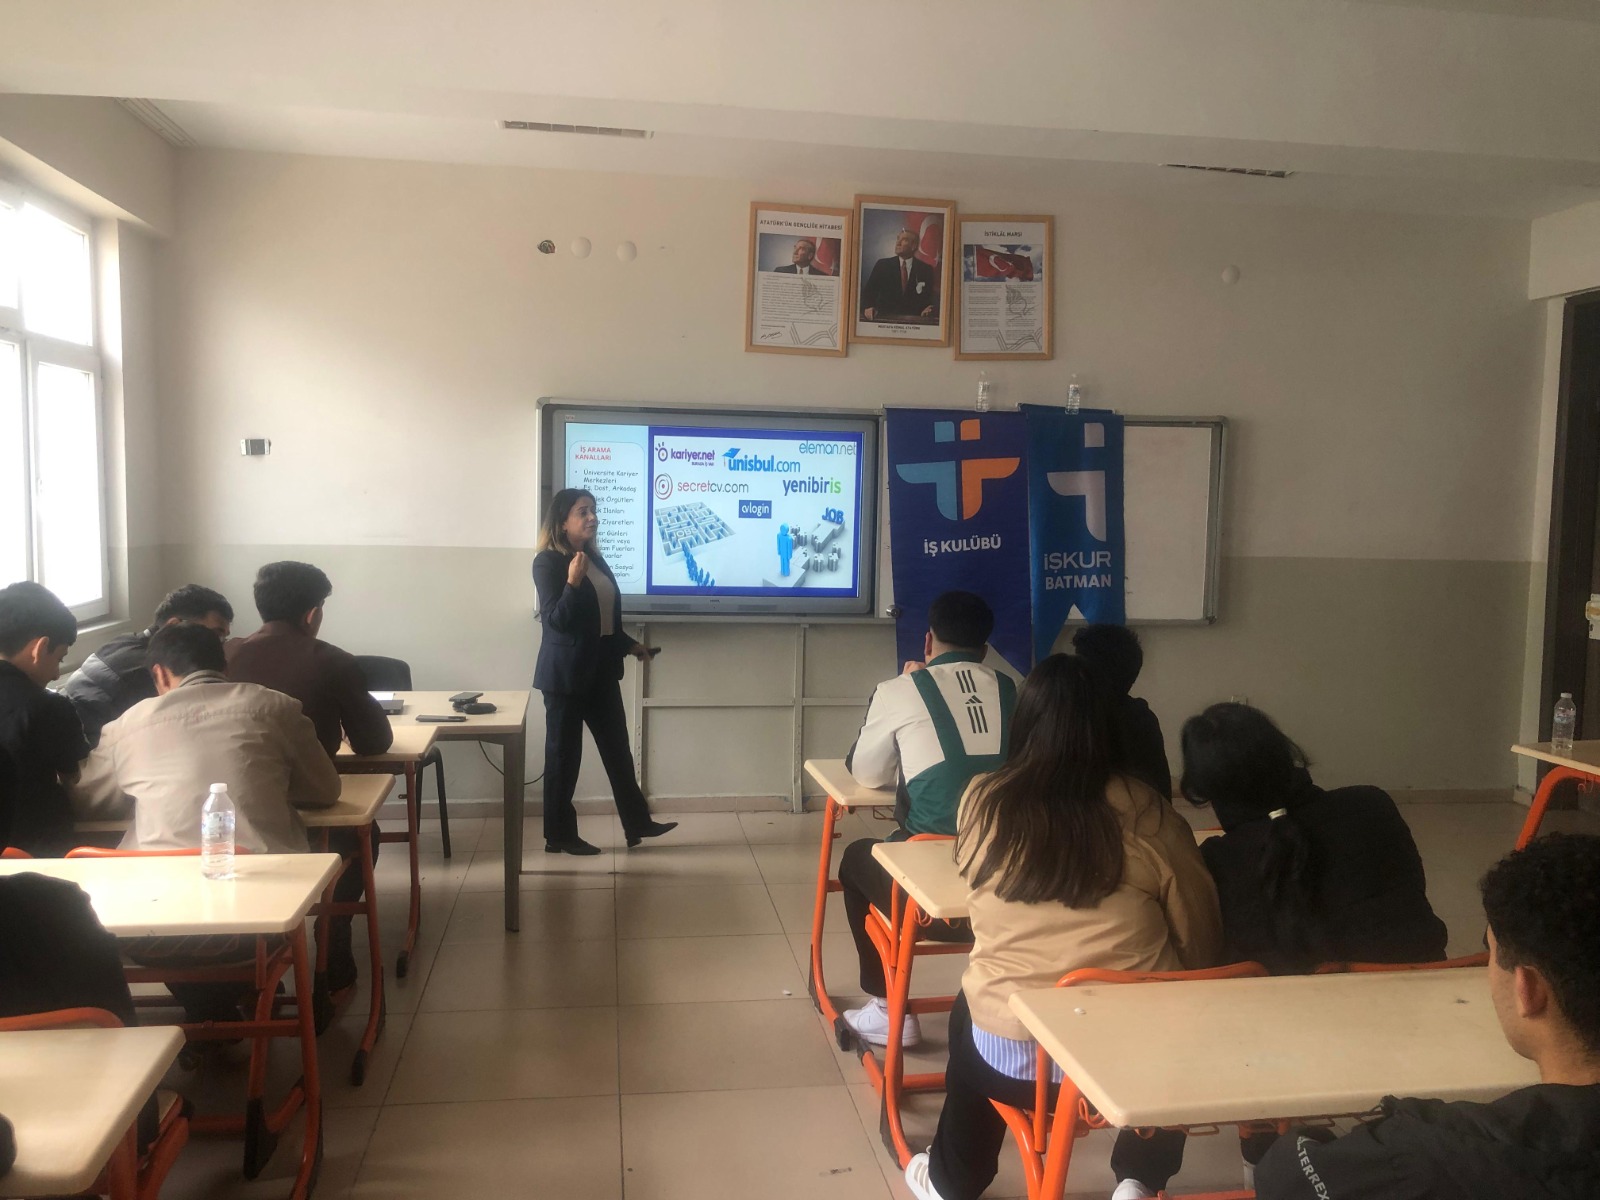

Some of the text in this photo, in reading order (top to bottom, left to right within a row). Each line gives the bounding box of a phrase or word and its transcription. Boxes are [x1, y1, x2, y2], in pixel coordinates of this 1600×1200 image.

[671, 448, 715, 462] kariyer.net
[799, 441, 857, 455] eleman.net
[617, 470, 639, 478] Kariyer
[677, 480, 749, 493] secretcv.com
[783, 476, 842, 496] yenibiris
[822, 507, 845, 524] JOB
[924, 533, 1002, 557] İŞ KULÜBÜ
[1043, 550, 1112, 573] İŞKUR
[1045, 574, 1112, 590] BATMAN
[1298, 1147, 1330, 1200] TERREX
